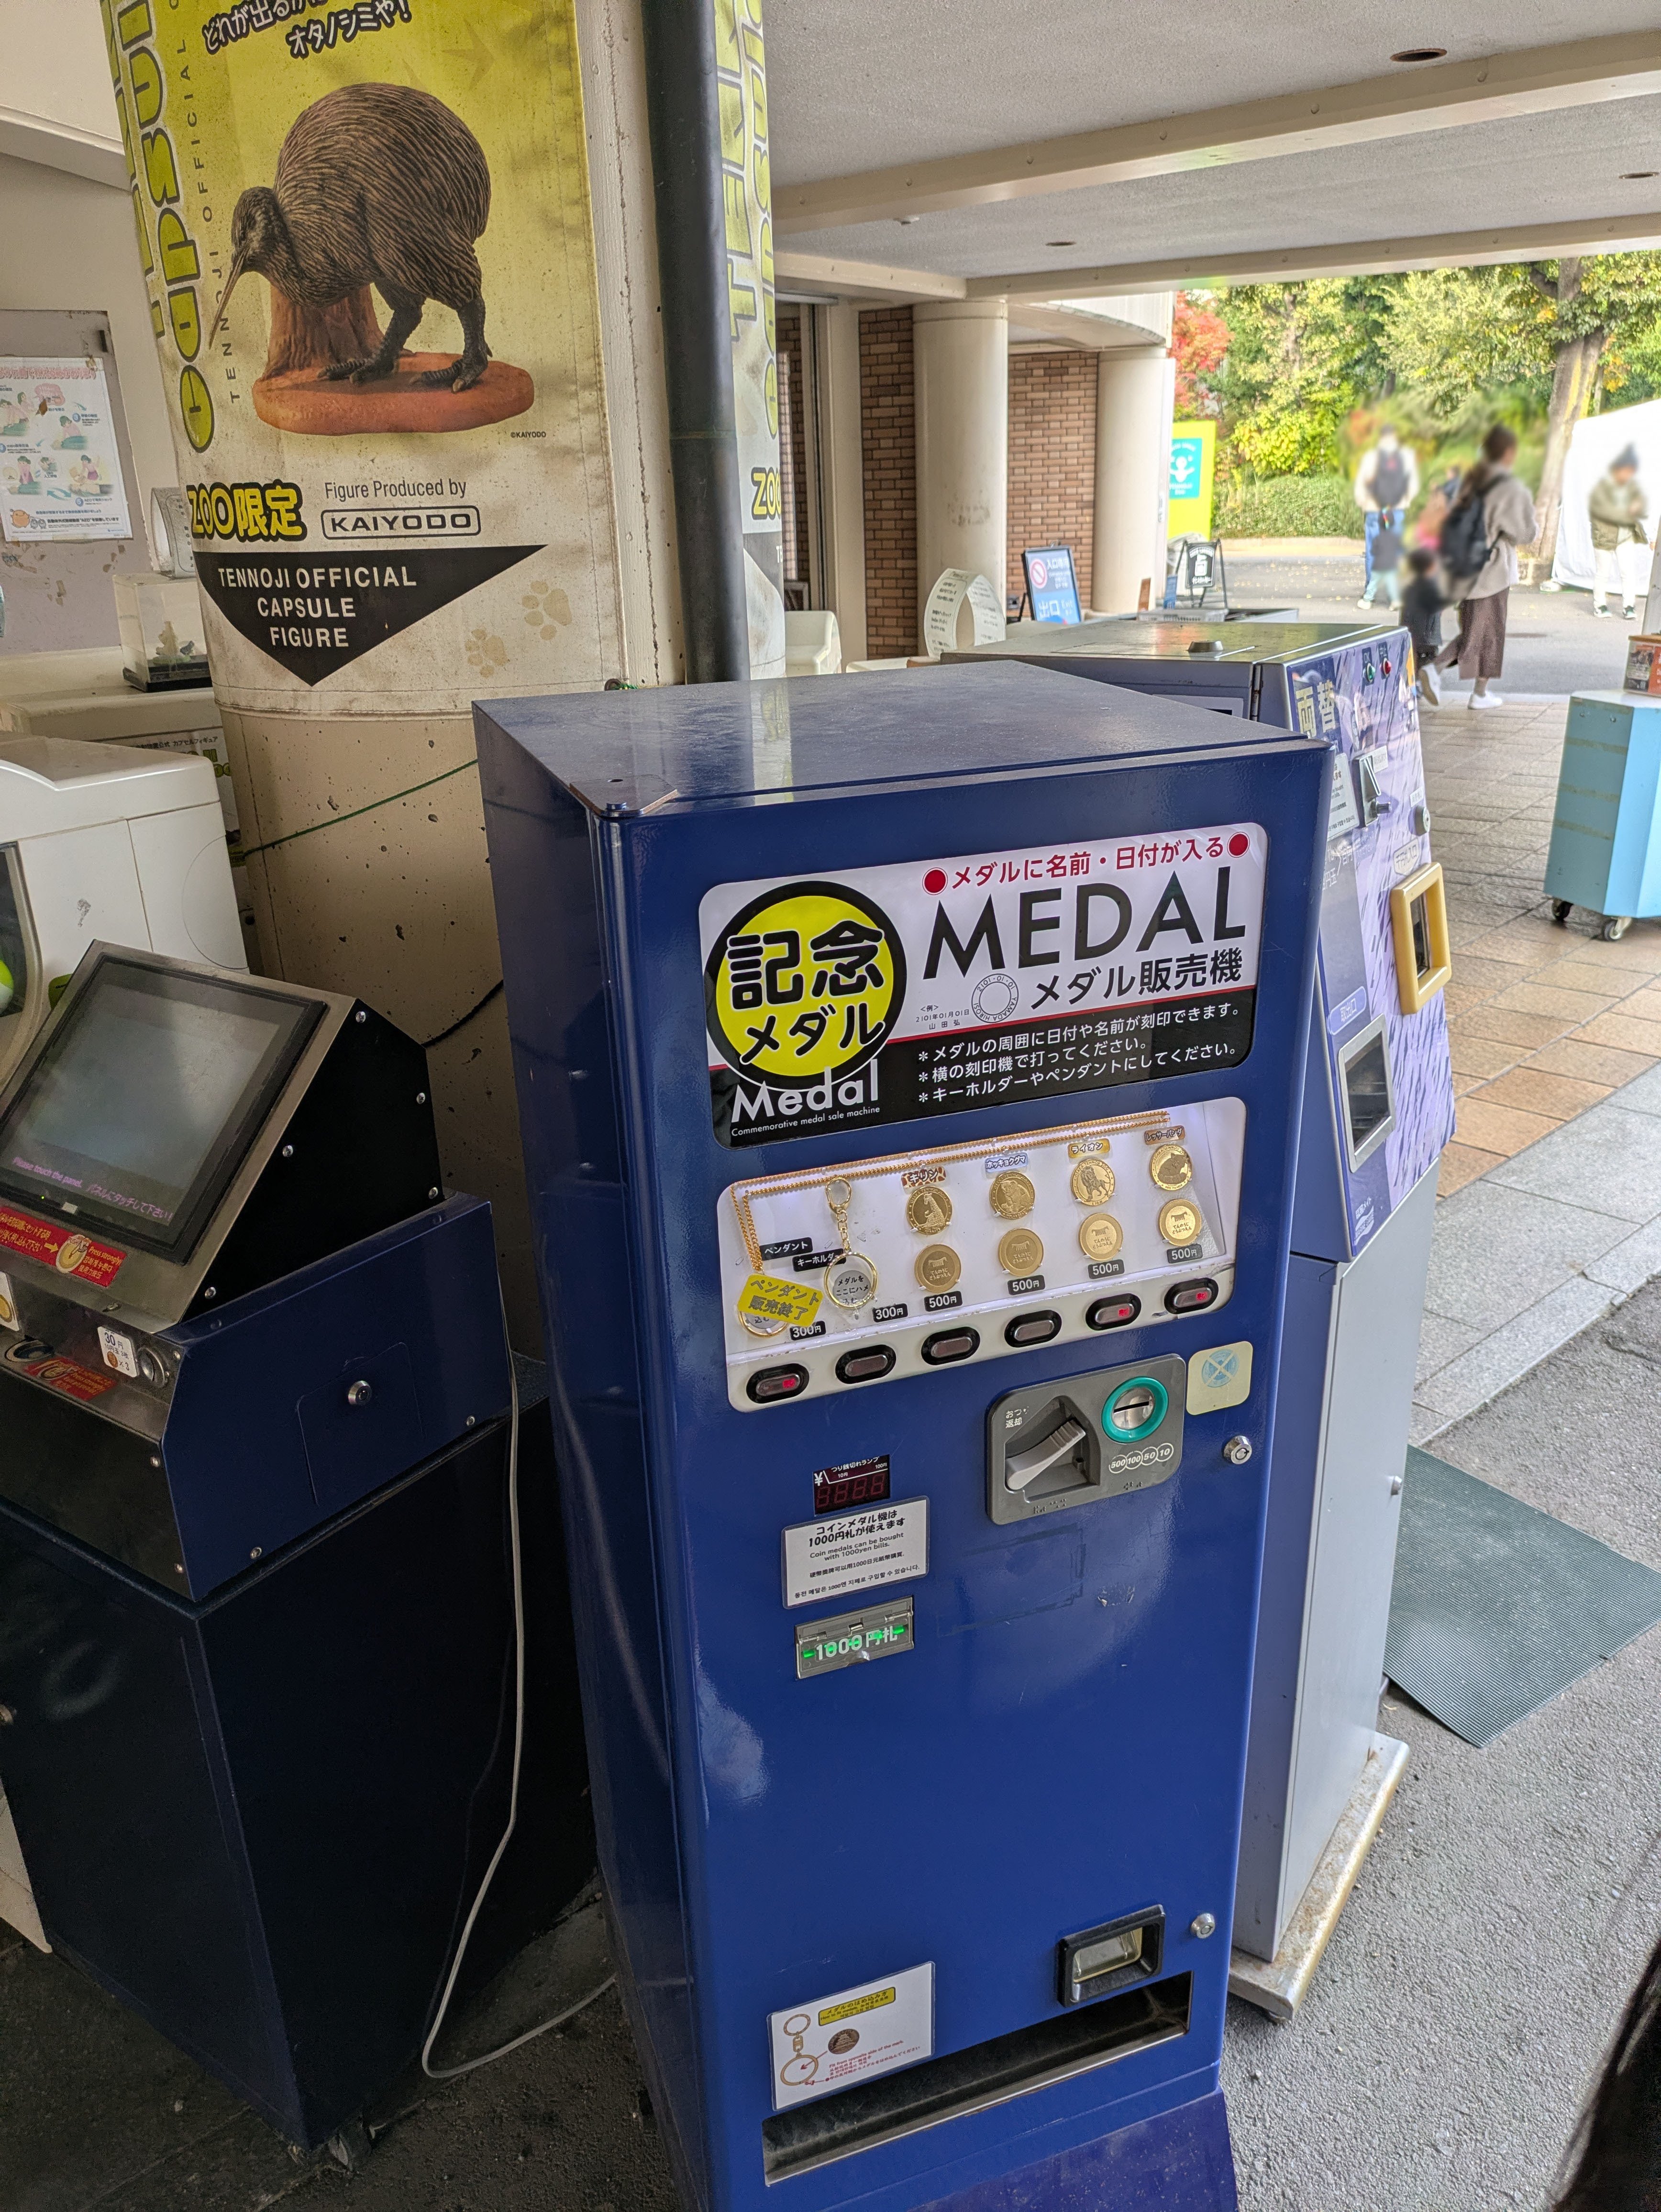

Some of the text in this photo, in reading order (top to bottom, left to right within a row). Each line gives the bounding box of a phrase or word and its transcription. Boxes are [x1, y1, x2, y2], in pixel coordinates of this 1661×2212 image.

[203, 0, 306, 53] どれが出る
[177, 39, 213, 222] OFFICIAL
[325, 479, 467, 499] Figure Produced by
[188, 480, 305, 541] ZOO限定
[331, 512, 472, 532] KAIYODO
[218, 566, 417, 589] TENNOJI OFFICIAL
[257, 597, 356, 619] CAPSULE
[1038, 599, 1061, 619] 出口
[270, 627, 349, 648] FIGURE
[1295, 679, 1337, 737] 両替
[952, 836, 1224, 889] メダルに名前・日付が入る
[923, 866, 1246, 980] MEDAL
[727, 920, 885, 1010] 記念
[1031, 947, 1243, 1010] メダル販売機
[740, 1002, 885, 1065] メダル
[731, 1059, 878, 1123] Medal
[731, 1106, 881, 1137] Commemorative medal sale machine
[1146, 1128, 1183, 1141] レッサーパンダ
[1071, 1142, 1104, 1154] ライオン
[986, 1155, 1026, 1169] ホッキョクグマ
[909, 1171, 939, 1183] キリン
[89, 1246, 102, 1257] Press
[764, 1241, 808, 1254] ペンダント
[1172, 1248, 1197, 1260] 500円
[1093, 1263, 1119, 1276] 500円
[751, 1279, 819, 1305] ペンダント
[1012, 1279, 1040, 1292] 500円
[748, 1295, 808, 1320] 販売終了
[929, 1295, 957, 1308] 500円
[875, 1307, 904, 1321] 300円
[792, 1324, 822, 1338] 300円
[1005, 1418, 1023, 1429] 返却
[1127, 1455, 1142, 1464] 100
[1144, 1451, 1156, 1460] 50
[1160, 1448, 1170, 1457] 10
[808, 1517, 906, 1547] 1000円札が使えます
[816, 1509, 898, 1535] コインメダル機は
[809, 1550, 826, 1559] Coin
[828, 1544, 853, 1555] medals
[879, 1532, 904, 1544] bought
[824, 1542, 890, 1561] with 1000yen bills.
[795, 1591, 807, 1599] 동전
[868, 1572, 886, 1581] 구입할
